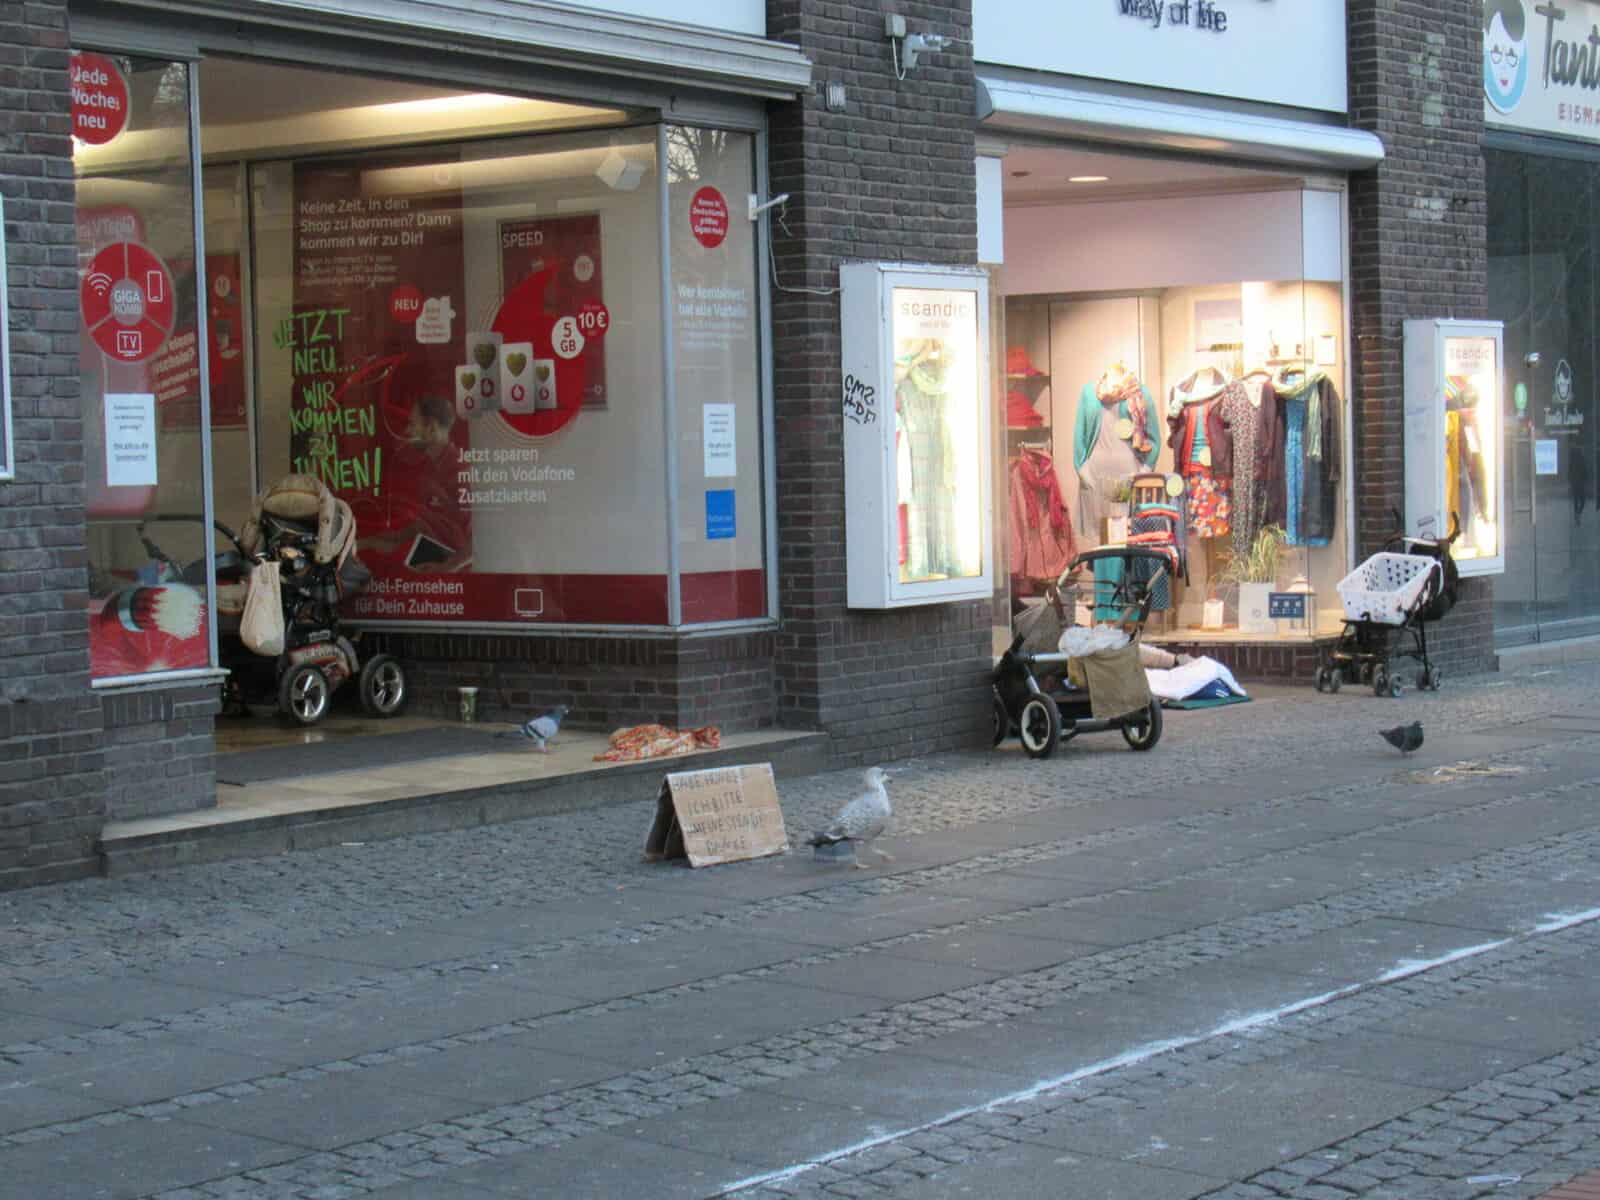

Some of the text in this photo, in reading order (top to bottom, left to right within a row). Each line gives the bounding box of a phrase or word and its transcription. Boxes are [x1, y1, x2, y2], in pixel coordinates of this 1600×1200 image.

[78, 113, 106, 129] neu
[300, 219, 332, 234] Shop
[333, 220, 349, 230] zu
[417, 213, 451, 226] Dann
[300, 236, 355, 249] kommen
[358, 233, 379, 247] wir
[381, 235, 398, 246] zu
[503, 231, 543, 248] SPEED
[114, 290, 140, 301] GIGA
[394, 300, 418, 312] NEU
[273, 310, 351, 349] JETZT
[563, 322, 572, 338] 5
[121, 335, 137, 348] TV
[560, 340, 577, 352] GB
[303, 379, 340, 409] WIR
[288, 403, 377, 438] KOMMEN
[309, 432, 337, 457] ZU
[458, 448, 539, 464] Jetzt sparen
[458, 465, 576, 482] mit den Vodafone
[458, 487, 547, 504] Zusatzkarten
[376, 599, 405, 614] Dein
[408, 600, 465, 615] Zuhause
